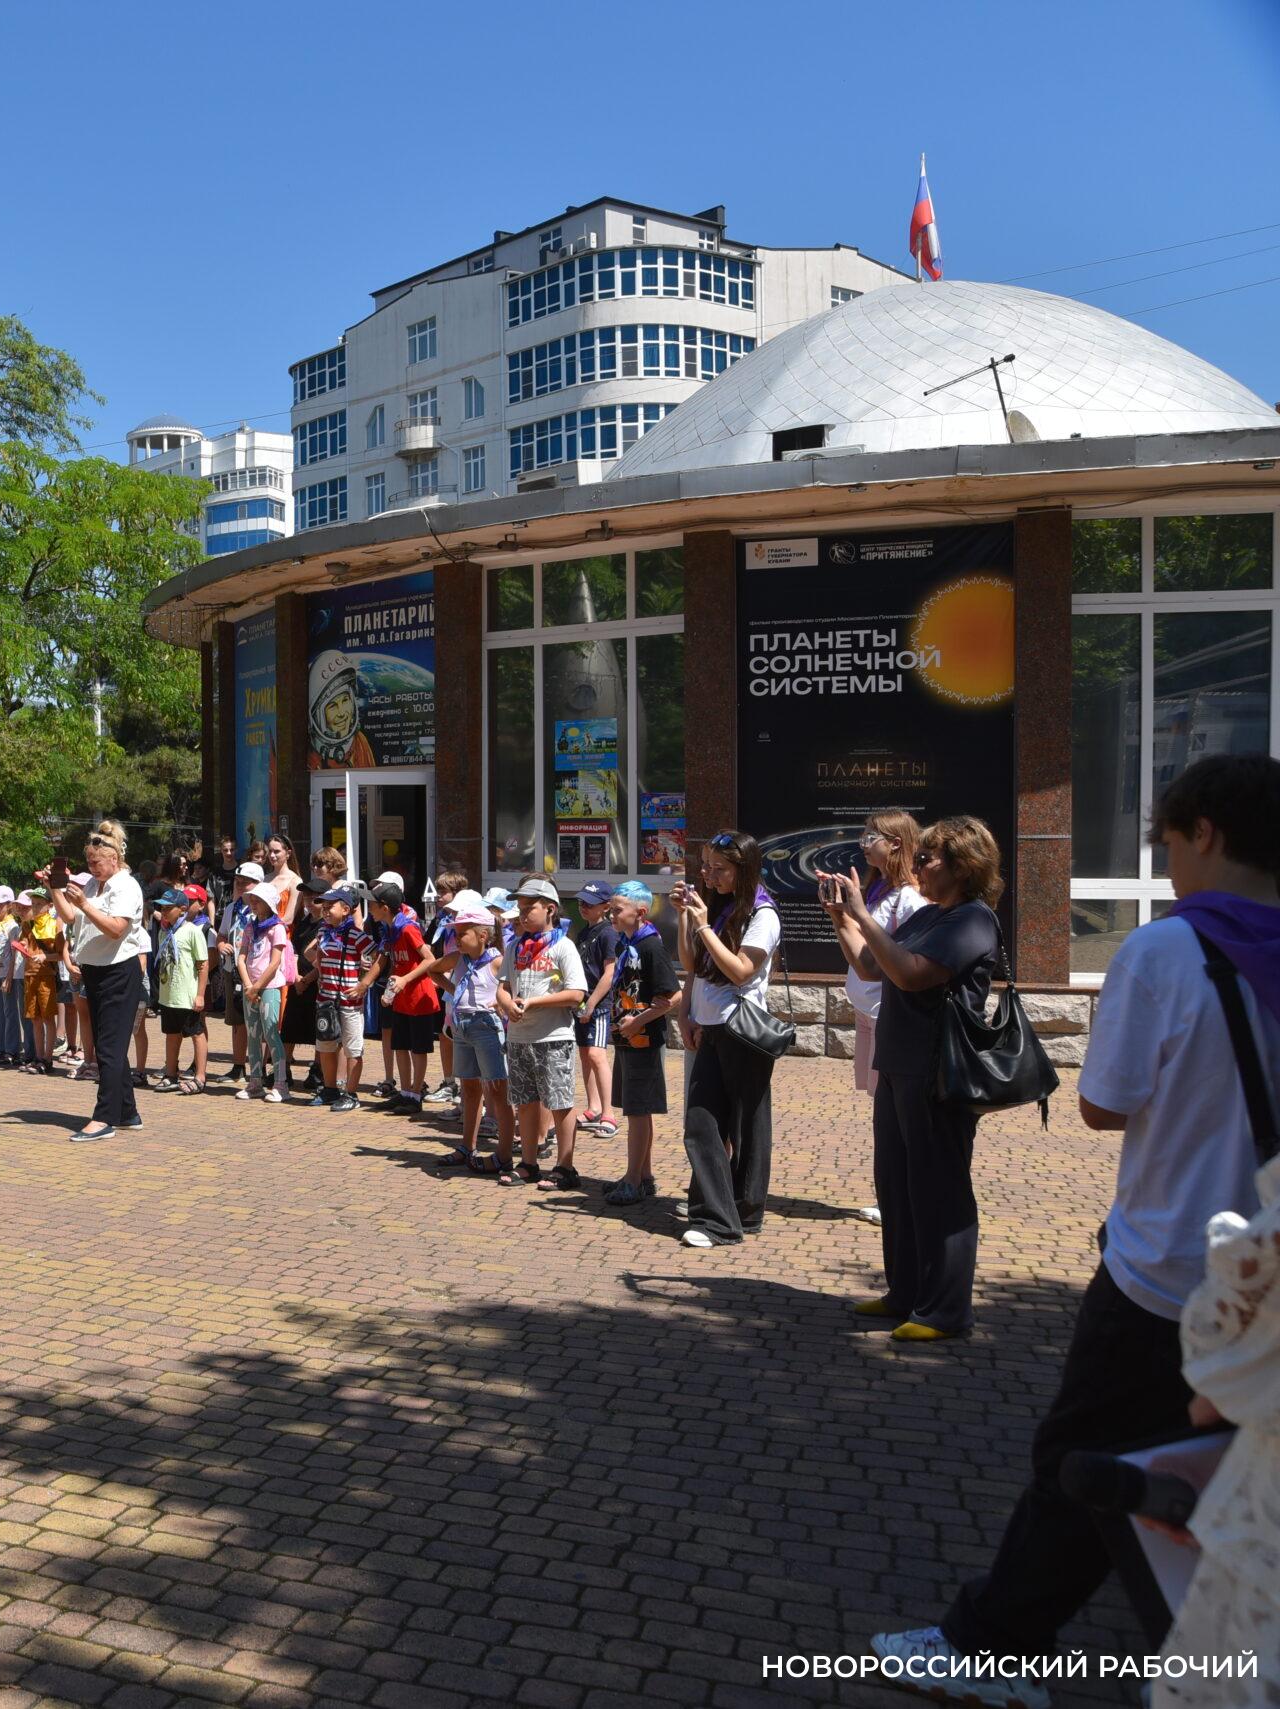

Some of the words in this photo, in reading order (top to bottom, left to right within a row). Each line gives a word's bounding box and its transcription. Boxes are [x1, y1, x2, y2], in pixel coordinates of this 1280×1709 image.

[861, 549, 933, 561] «ПРИТЯЖЕНИЕ»
[346, 637, 363, 649] им.
[749, 628, 897, 652] ПЛАНЕТЫ
[749, 644, 941, 675] СОЛНЕЧНОЙ
[321, 654, 351, 680] СССР
[749, 674, 903, 697] СИСТЕМЫ
[368, 695, 392, 705] ЧАСЫ
[367, 708, 402, 718] ежедневно
[817, 761, 927, 777] ПЛАНЕТЫ
[559, 823, 608, 832] ИНФОРМАЦИЯ
